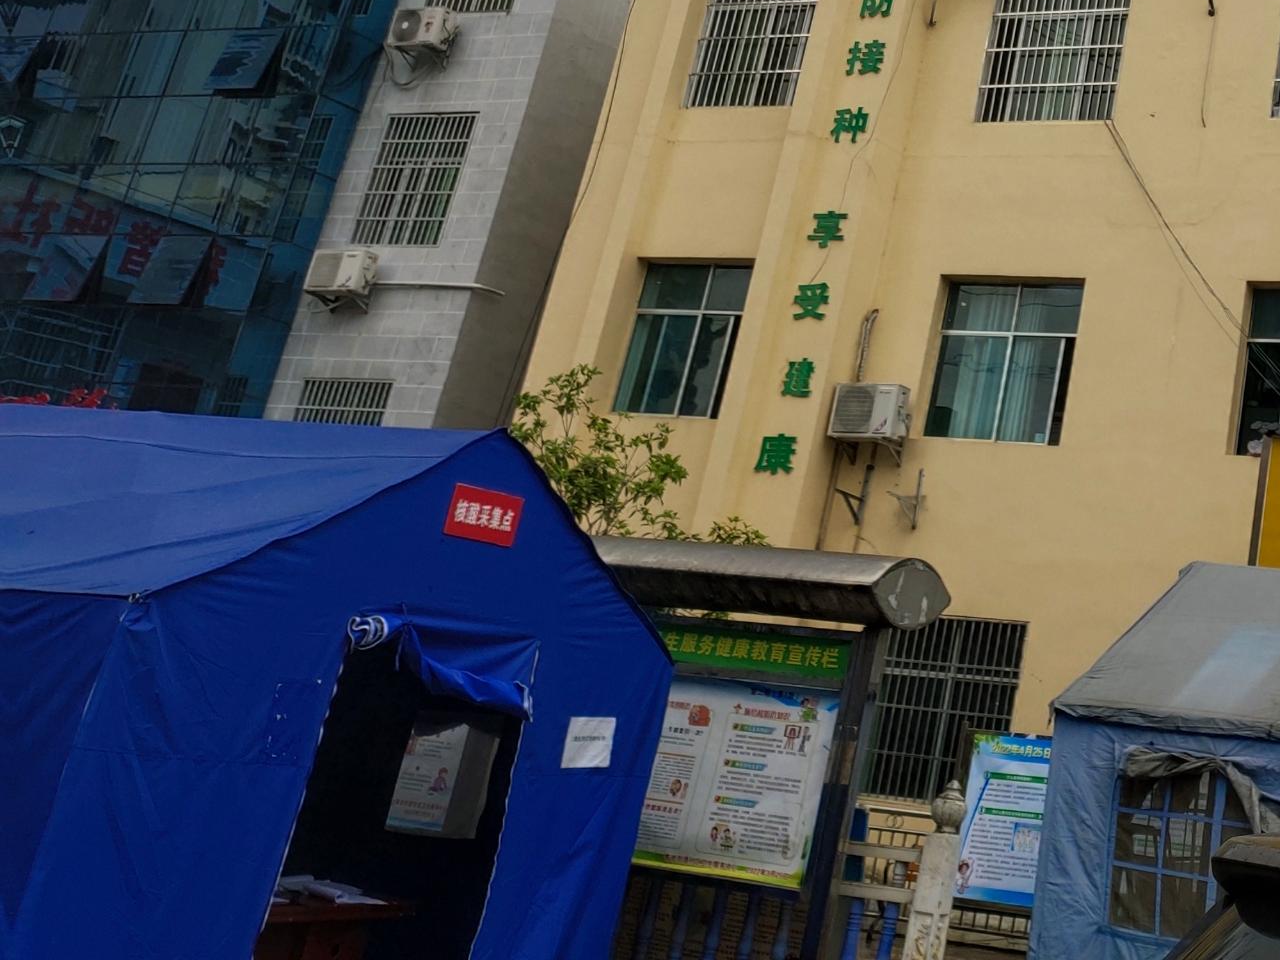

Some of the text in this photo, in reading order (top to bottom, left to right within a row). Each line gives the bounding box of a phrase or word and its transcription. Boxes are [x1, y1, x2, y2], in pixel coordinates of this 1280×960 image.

[454, 498, 515, 532] 核酸采集点
